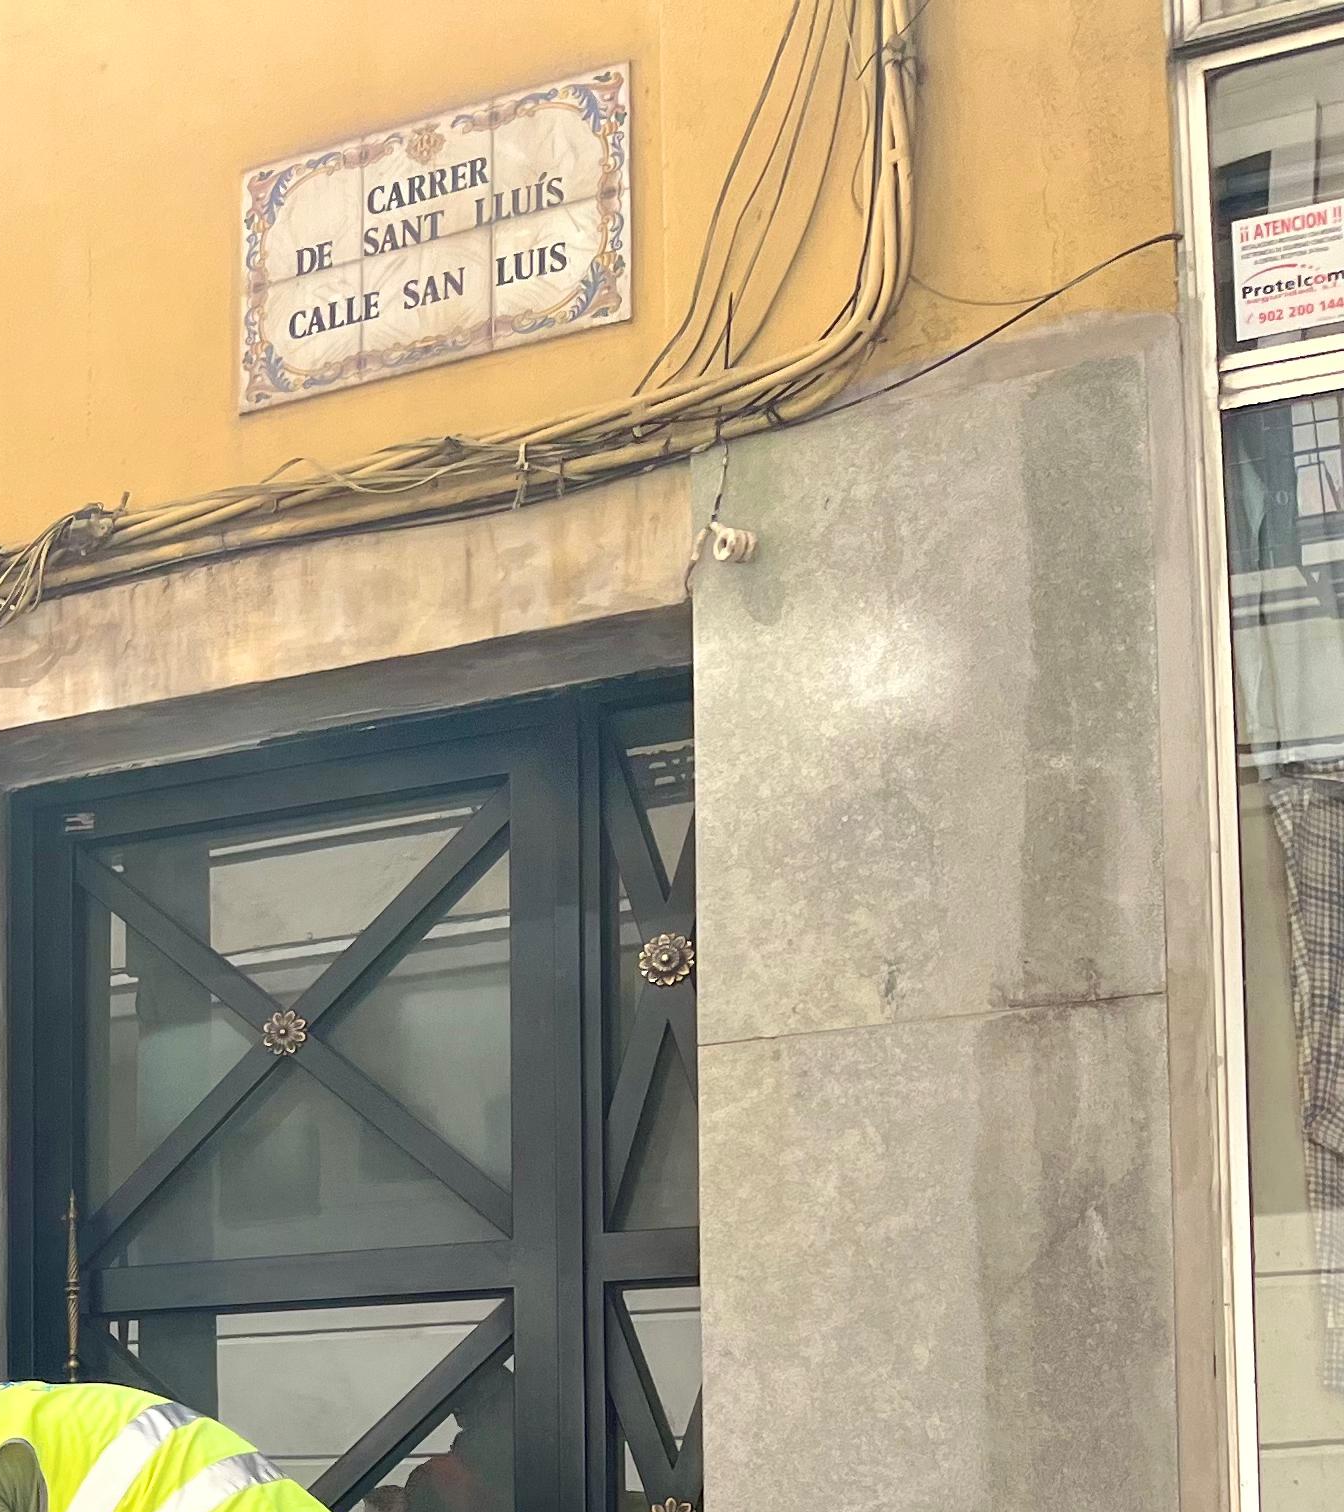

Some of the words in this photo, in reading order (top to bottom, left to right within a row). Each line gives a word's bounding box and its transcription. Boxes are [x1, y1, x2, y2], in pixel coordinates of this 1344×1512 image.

[366, 156, 490, 215] CARRER
[296, 240, 333, 277] DE
[363, 210, 445, 258] SANT
[475, 171, 566, 230] LLUÍS
[1253, 209, 1328, 240] ATENCION
[288, 290, 380, 340] CALLE
[402, 266, 466, 310] SAN
[496, 241, 569, 287] LUIS
[1258, 308, 1284, 324] 902
[1289, 303, 1314, 319] 200
